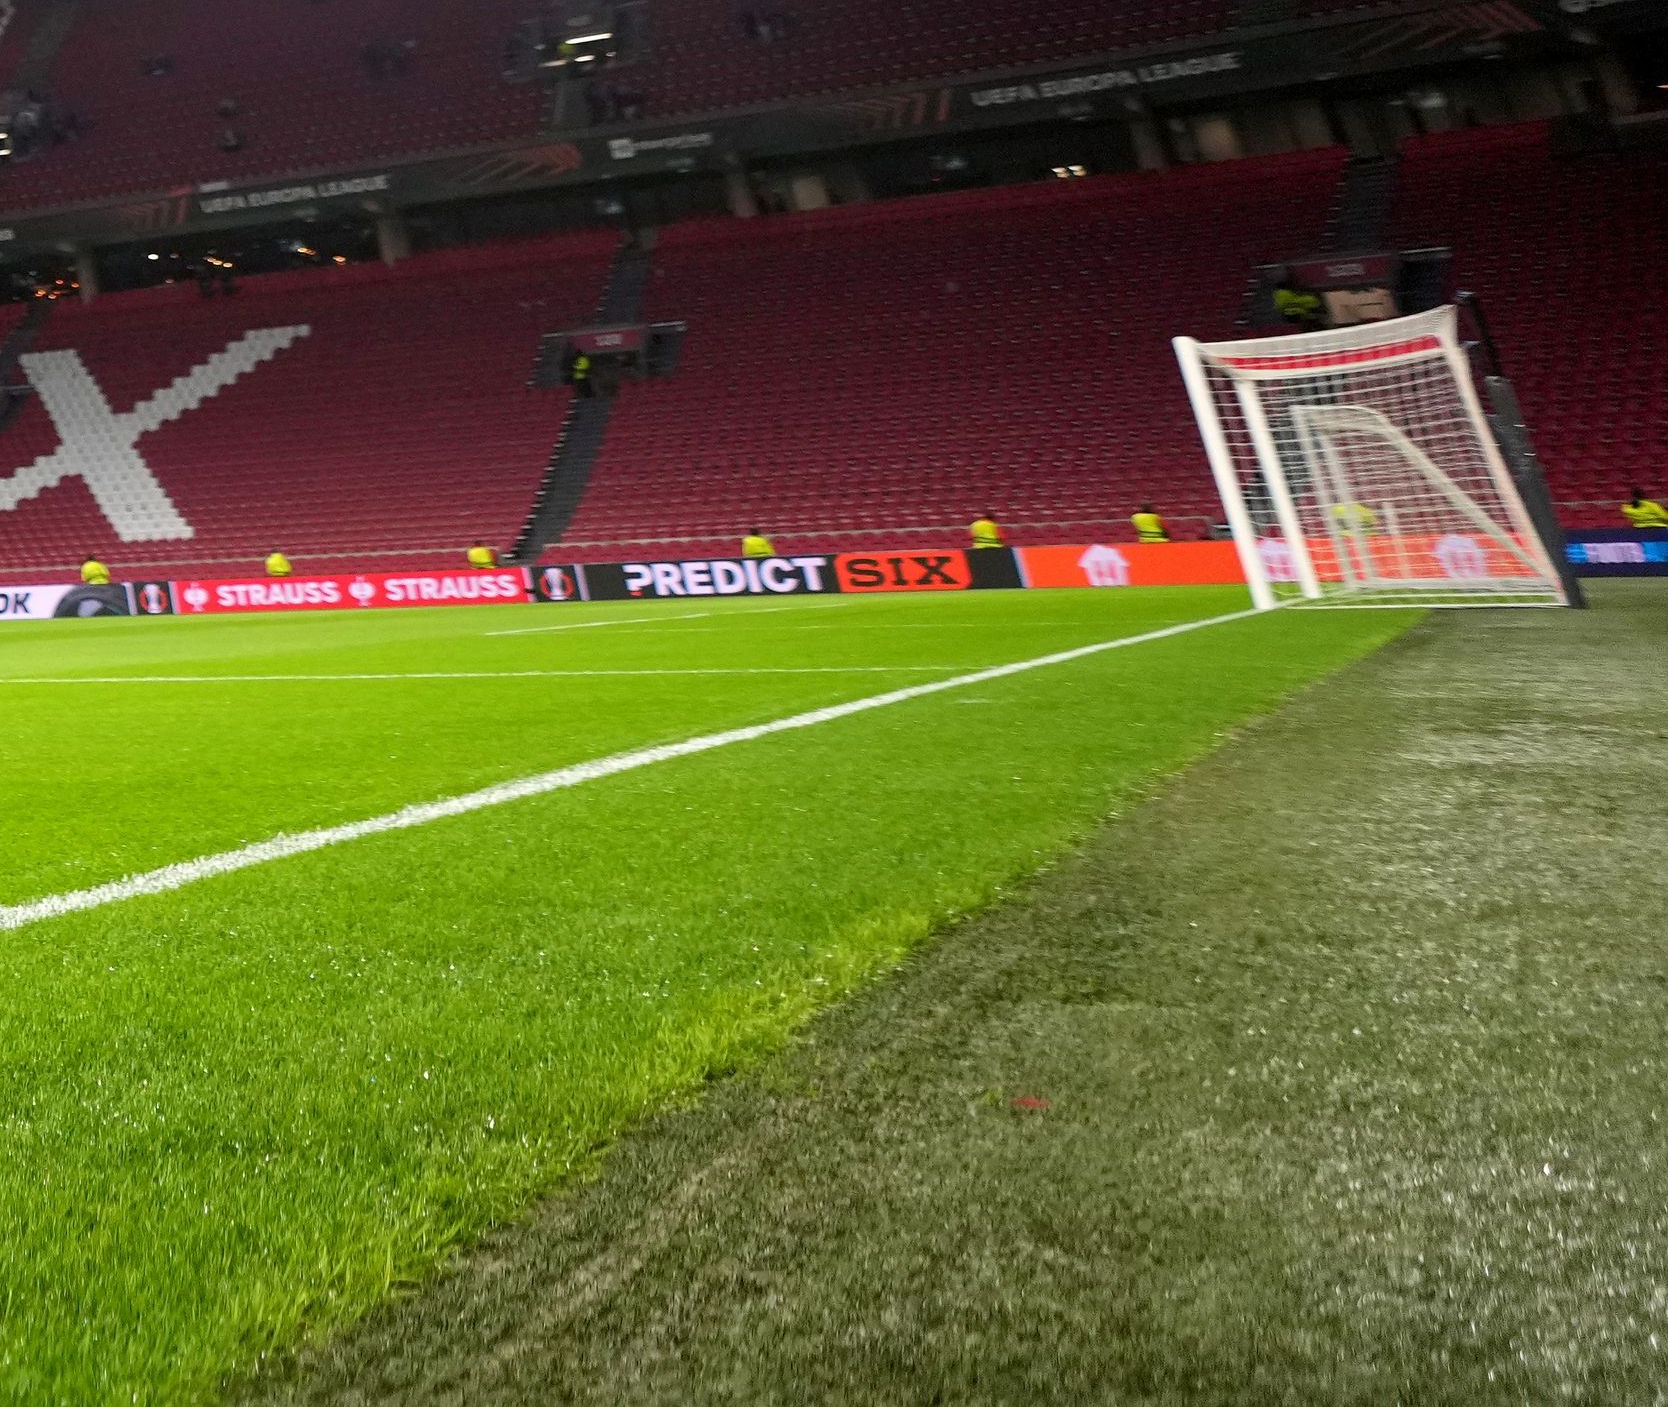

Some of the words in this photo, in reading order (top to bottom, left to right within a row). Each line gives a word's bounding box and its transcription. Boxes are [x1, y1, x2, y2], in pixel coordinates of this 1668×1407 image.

[216, 580, 339, 607] STRAUSS
[384, 574, 519, 602] STRAUSS
[621, 556, 828, 597] PREDICT
[845, 555, 962, 589] SIX
